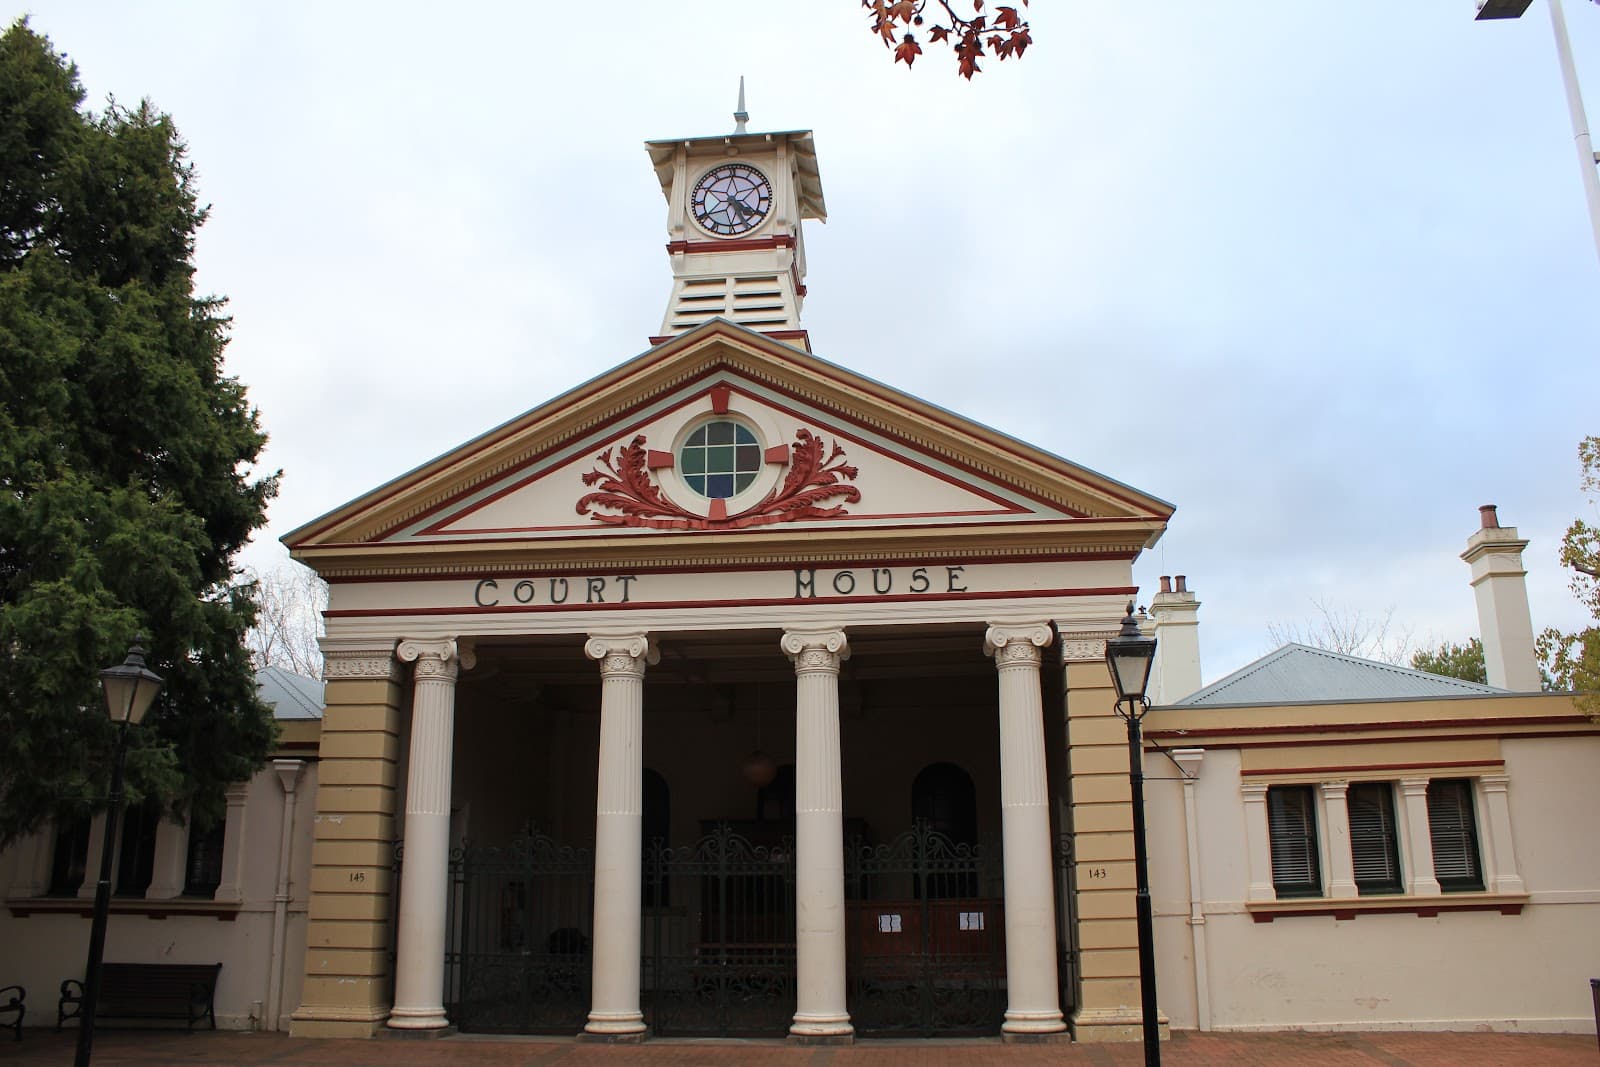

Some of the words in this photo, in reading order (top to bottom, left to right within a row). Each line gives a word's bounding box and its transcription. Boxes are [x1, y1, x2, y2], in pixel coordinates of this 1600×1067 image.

[475, 575, 637, 607] COURT
[794, 566, 968, 598] HOUSE
[349, 872, 365, 882] 145
[1089, 868, 1106, 879] 143
